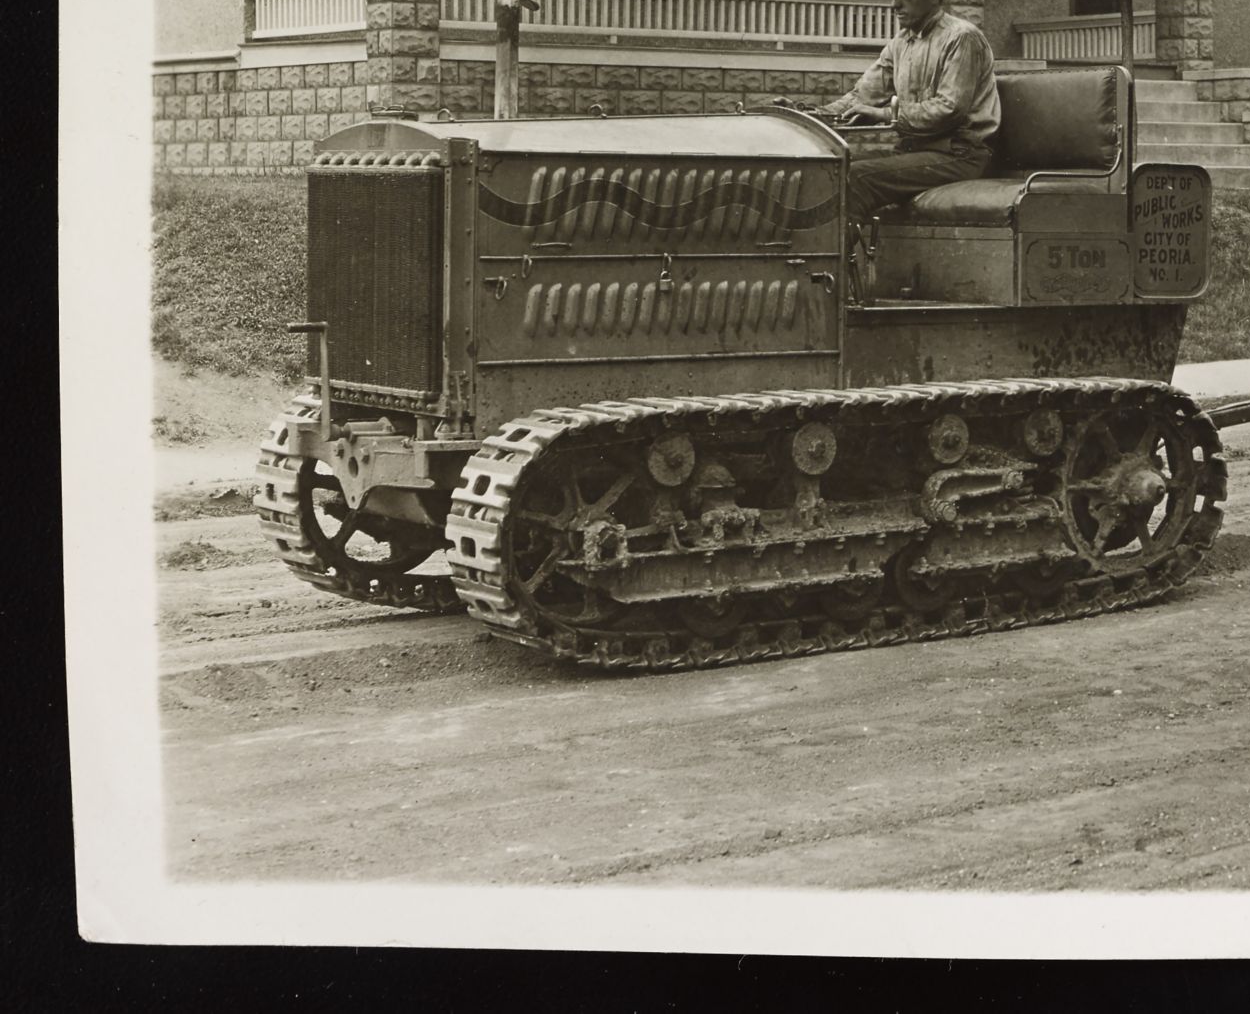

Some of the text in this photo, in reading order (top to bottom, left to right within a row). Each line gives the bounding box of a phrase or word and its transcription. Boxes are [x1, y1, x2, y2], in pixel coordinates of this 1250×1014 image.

[1179, 176, 1193, 191] OF
[1134, 195, 1177, 221] PUBLIC
[1162, 204, 1204, 229] WORKS
[1144, 232, 1192, 246] CITY OF
[1048, 245, 1063, 270] 5
